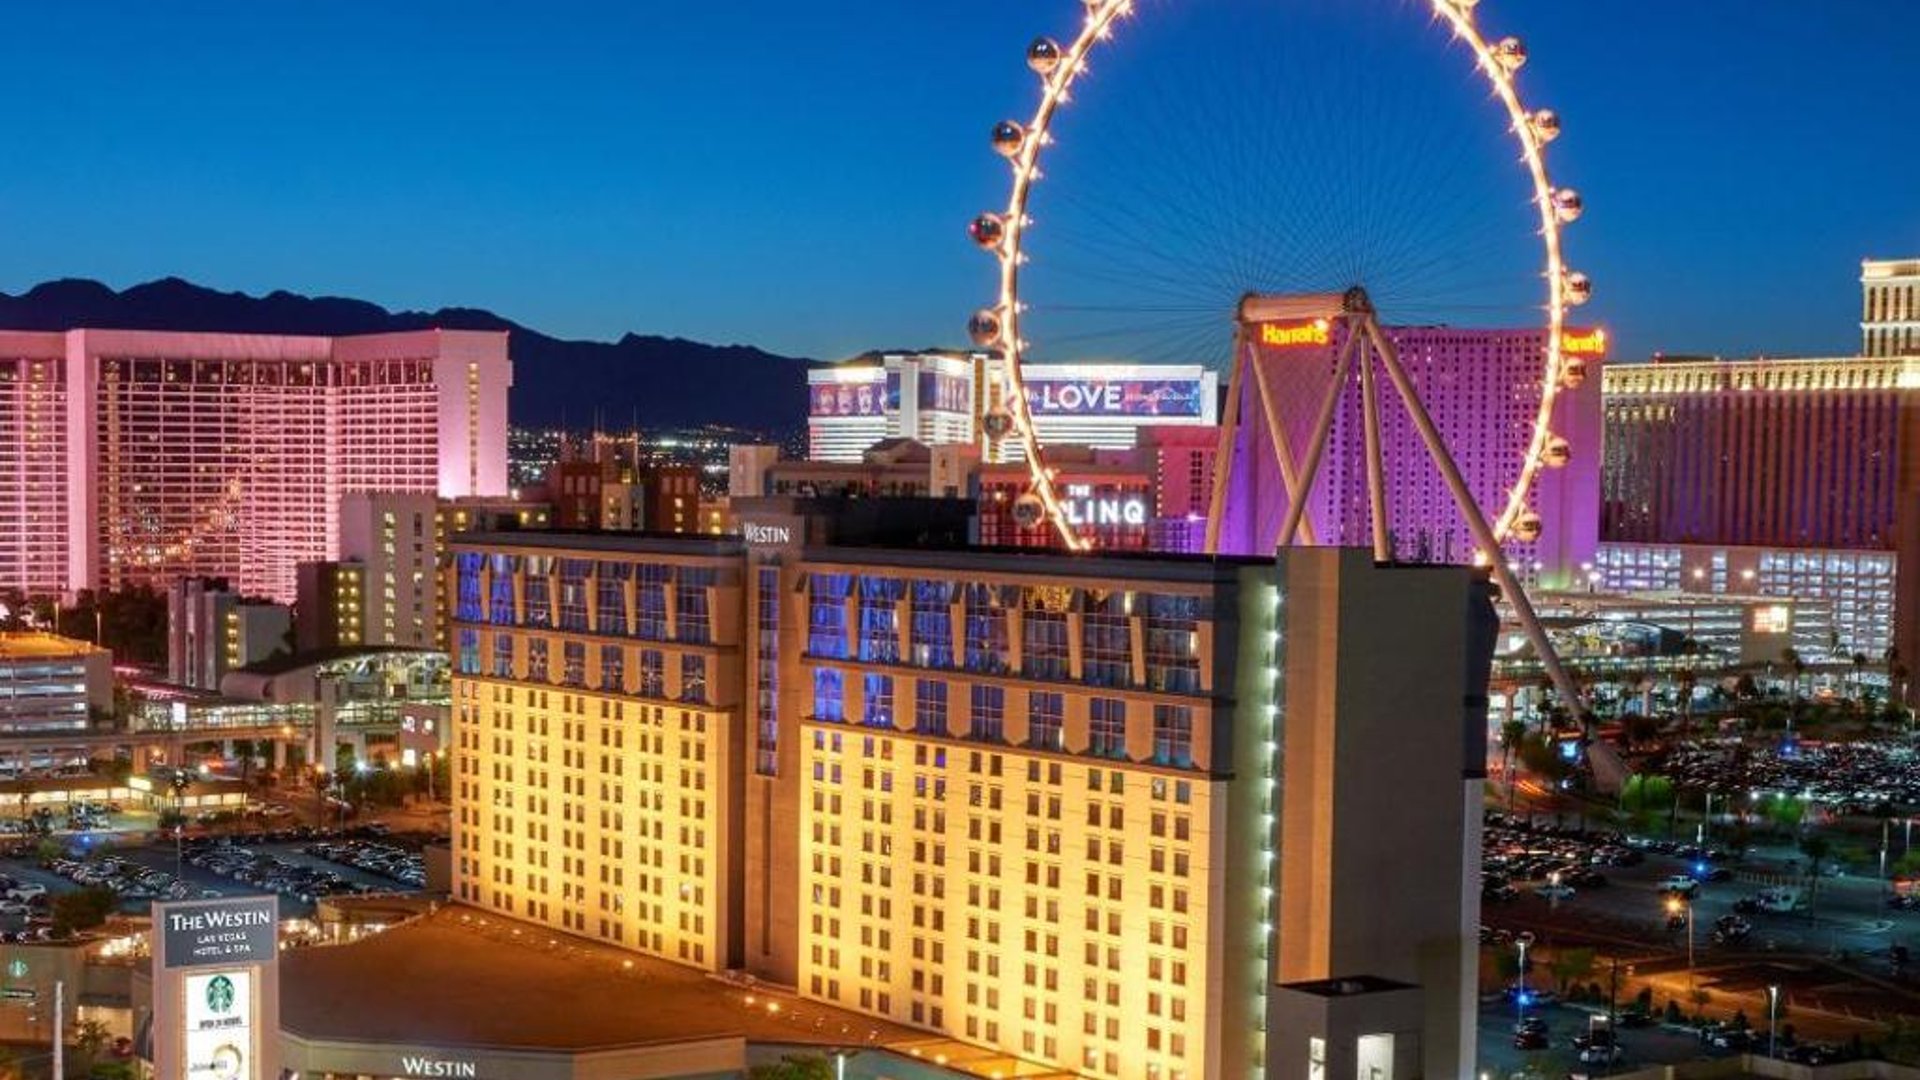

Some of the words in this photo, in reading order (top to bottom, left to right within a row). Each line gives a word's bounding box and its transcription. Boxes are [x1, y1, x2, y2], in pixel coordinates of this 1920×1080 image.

[1043, 384, 1121, 410] LOVE
[1069, 484, 1090, 496] THE
[1067, 499, 1145, 524] LINQ
[743, 521, 789, 543] WESTIN
[170, 913, 204, 931] THE
[204, 909, 271, 928] WESTIN
[197, 934, 216, 944] LAS
[218, 931, 247, 942] VEGAS
[233, 942, 251, 953] SPA
[402, 1056, 476, 1077] WESTIN
